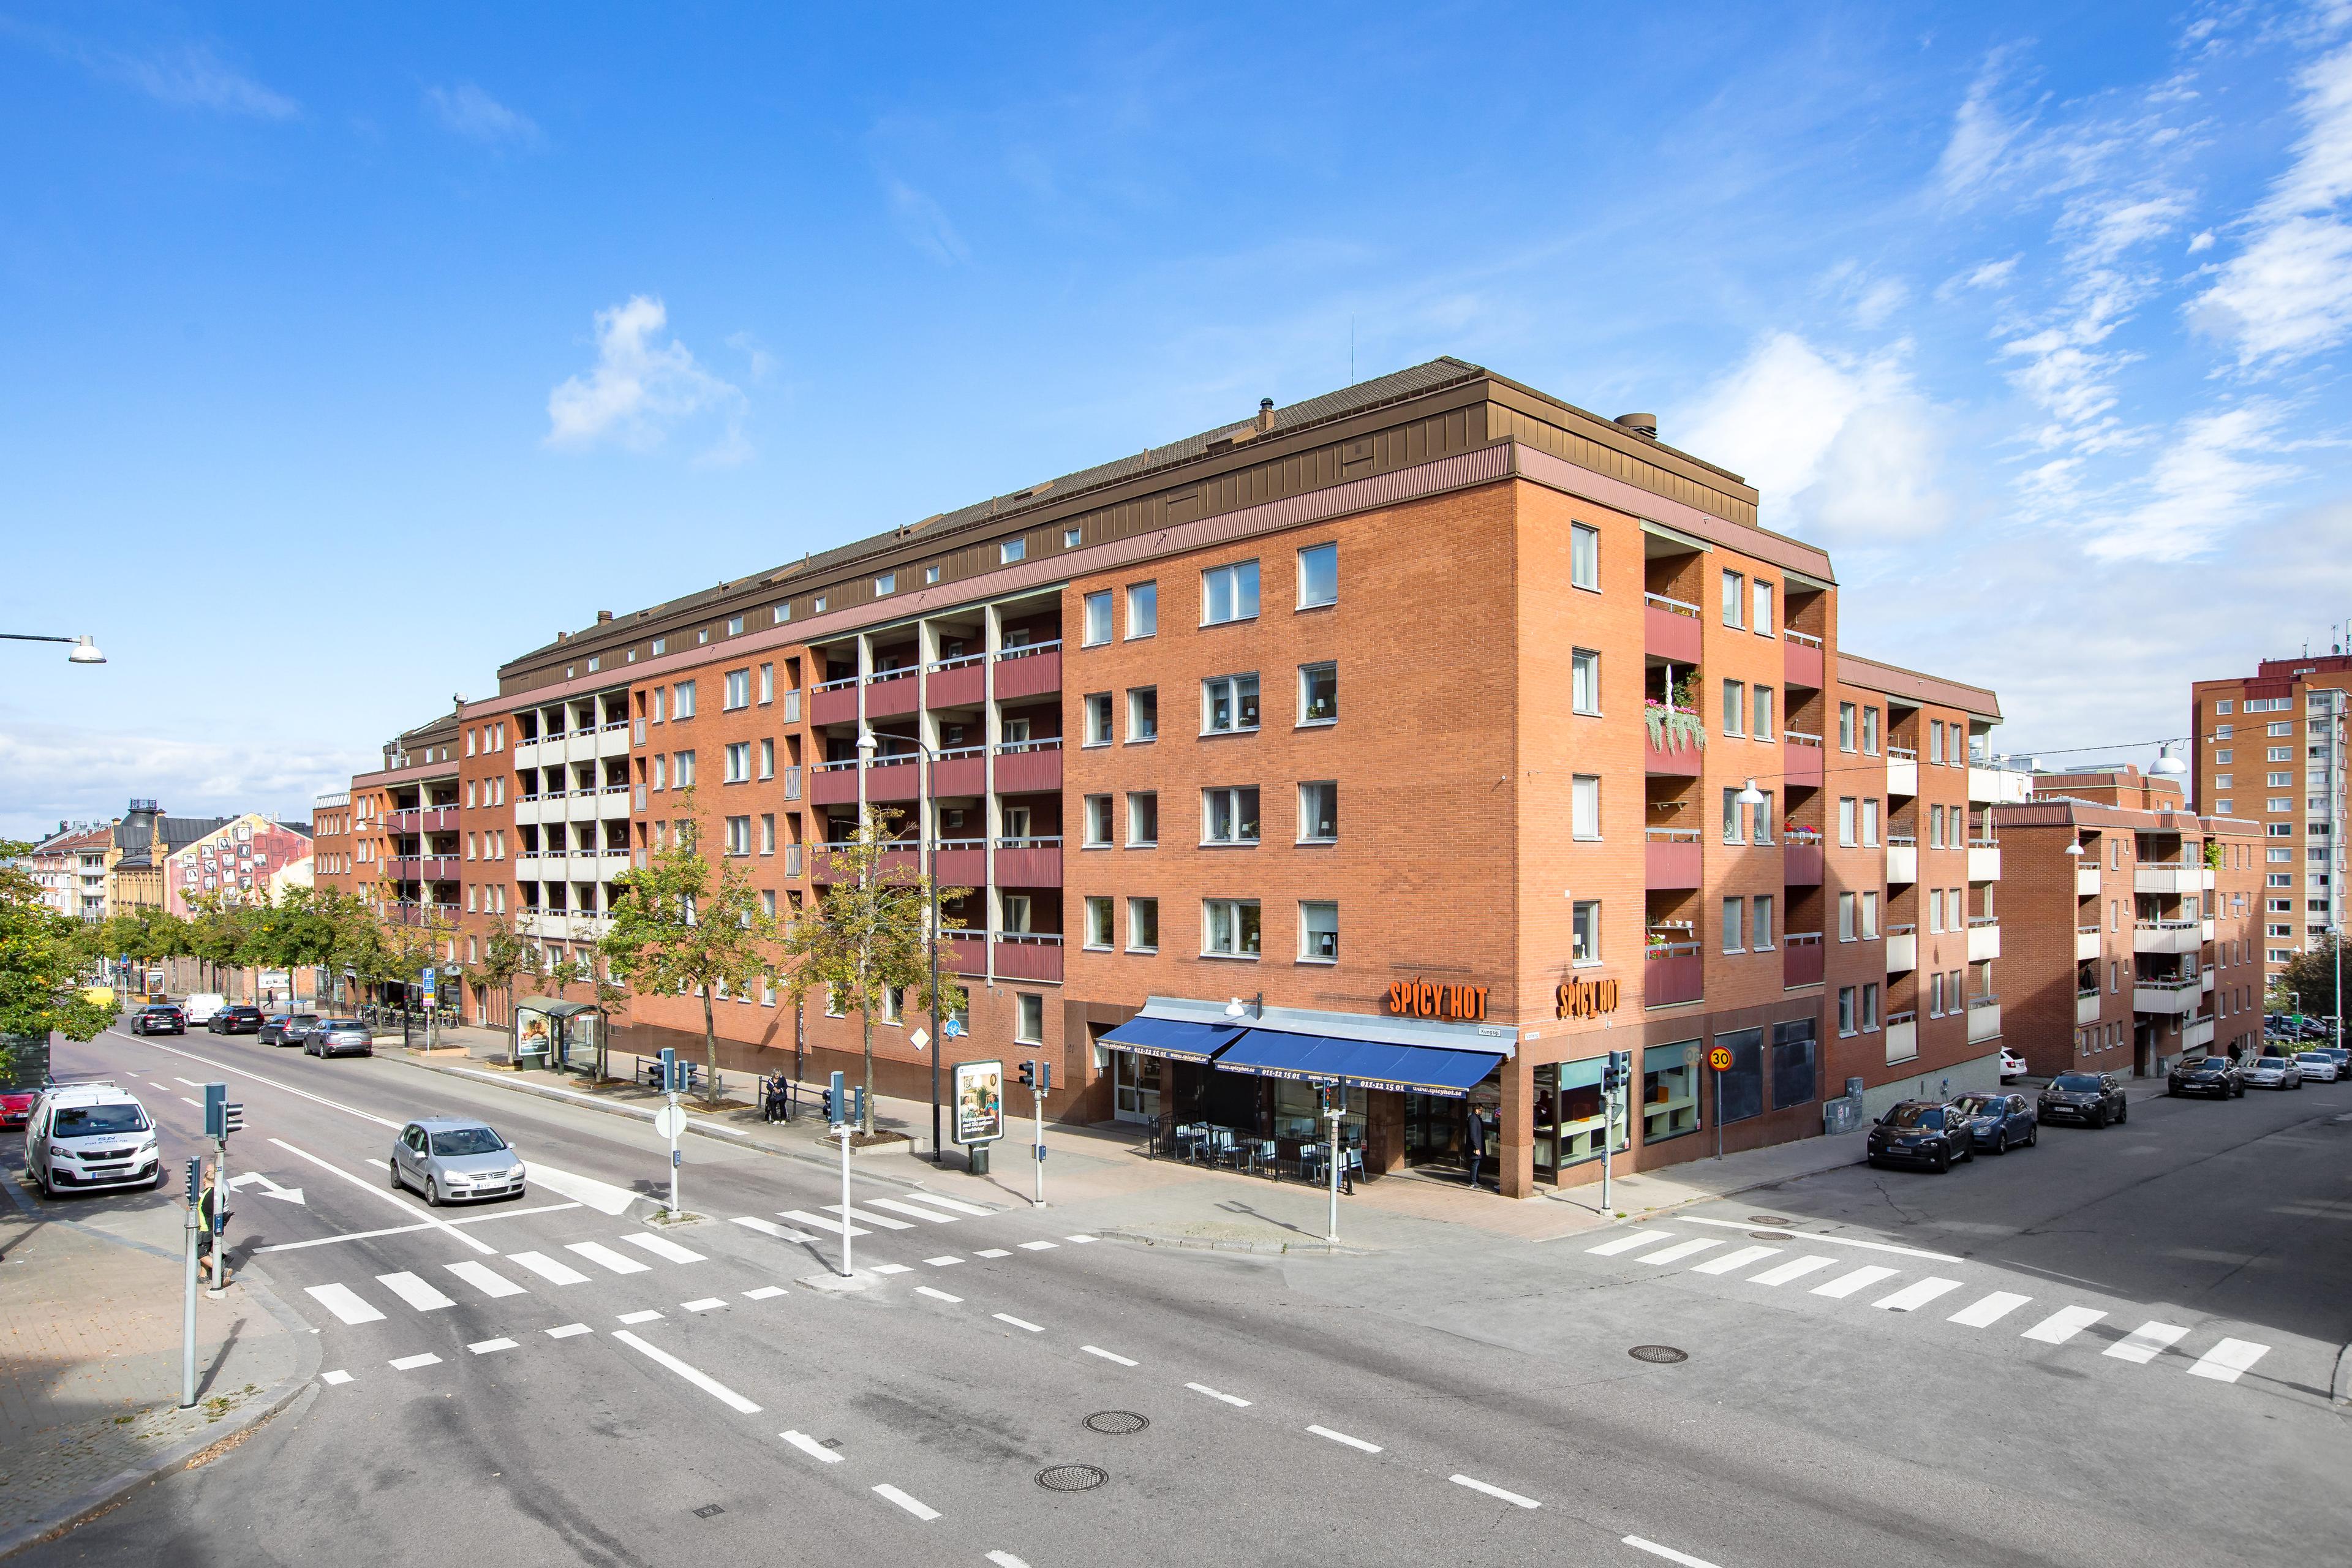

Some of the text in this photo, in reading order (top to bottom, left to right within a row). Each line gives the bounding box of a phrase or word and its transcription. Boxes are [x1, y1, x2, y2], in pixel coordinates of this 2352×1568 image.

[1390, 976, 1488, 1019] SPICY HOT
[1559, 976, 1621, 1017] SPICY HOT
[1713, 1053, 1728, 1065] 30
[1217, 1064, 1255, 1073] www.spicyhot.se
[1360, 1080, 1384, 1089] 011-12
[1412, 1086, 1462, 1096] www.spicyhot.se
